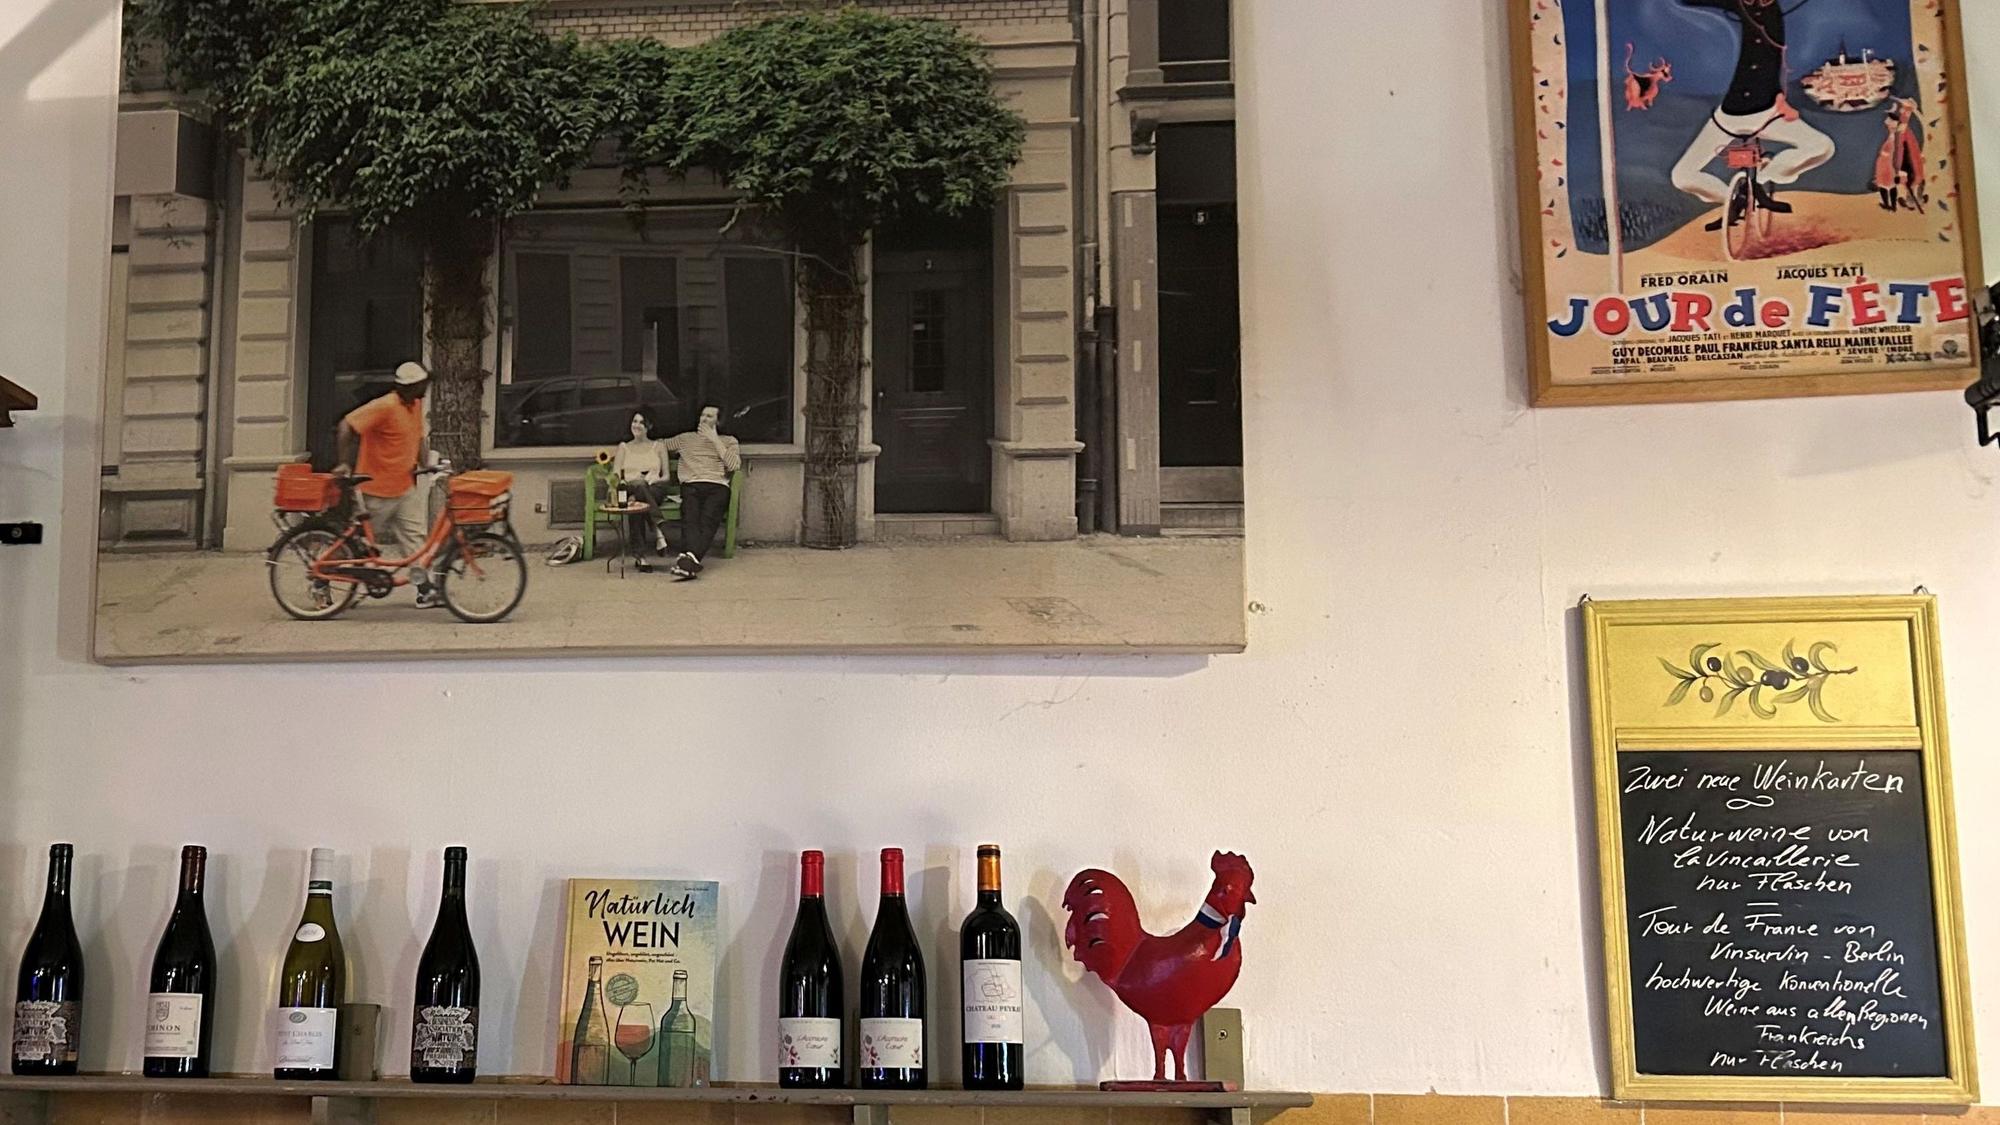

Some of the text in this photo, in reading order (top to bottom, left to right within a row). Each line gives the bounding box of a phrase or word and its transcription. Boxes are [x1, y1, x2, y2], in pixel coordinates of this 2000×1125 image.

[1640, 276, 1673, 287] FRED
[1678, 273, 1728, 285] ORAIN
[1777, 268, 1827, 280] JACQUES
[1832, 266, 1864, 277] TATI
[1547, 291, 1713, 336] JOUR
[1724, 288, 1790, 328] de
[1612, 347, 1636, 357] GUY
[1638, 344, 1691, 356] DECOMBLE
[1694, 342, 1720, 354] PAUL
[1723, 340, 1778, 352] FRANKEUR
[1668, 334, 1701, 342] JACQUES
[1730, 331, 1753, 340] HENRI
[1755, 329, 1791, 338] MARQUET
[1624, 759, 1904, 794] Zwei neue Weinkarten
[1638, 811, 1869, 845] Naturweine von
[1696, 870, 1852, 894] nur Flaschen
[585, 888, 695, 919] Natürlich
[603, 920, 680, 948] WEIN
[1638, 905, 1875, 938] Tour de France von
[1843, 940, 1905, 965] Berlin
[1645, 962, 1763, 999] hochwertige
[1703, 994, 1760, 1017] Weine
[1766, 1006, 1797, 1016] aus
[1856, 999, 1929, 1030] Regionen
[1753, 1022, 1866, 1049] Frankreichs
[1710, 1051, 1747, 1067] nur
